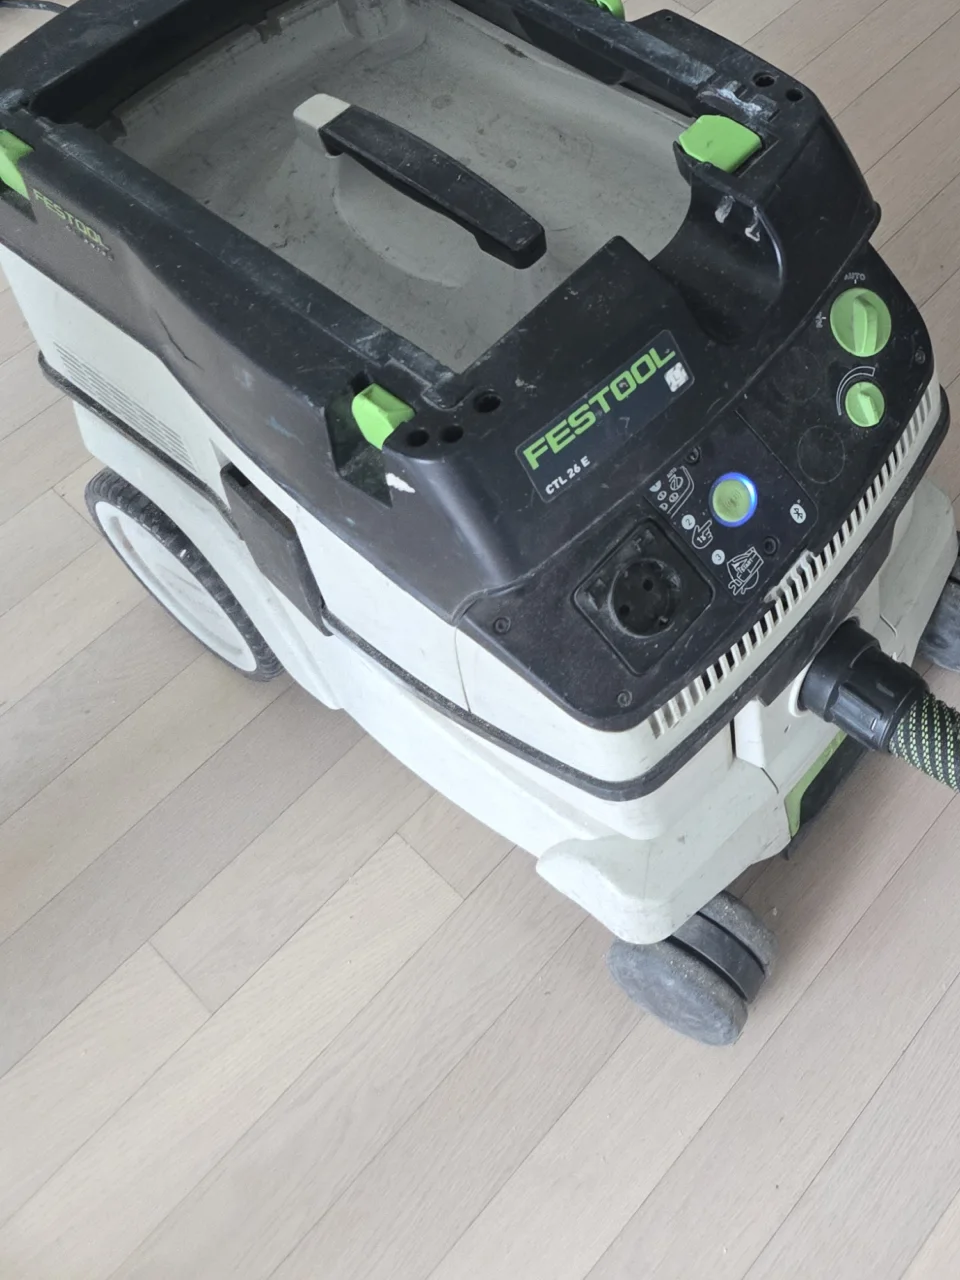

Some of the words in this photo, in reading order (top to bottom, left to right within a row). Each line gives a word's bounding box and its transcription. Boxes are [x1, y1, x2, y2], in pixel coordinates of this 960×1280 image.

[32, 188, 110, 250] FESTOOL
[844, 272, 866, 281] AUTO
[523, 348, 676, 470] FESTOOL
[545, 476, 567, 495] CTL
[567, 464, 581, 479] 26
[580, 456, 590, 468] E
